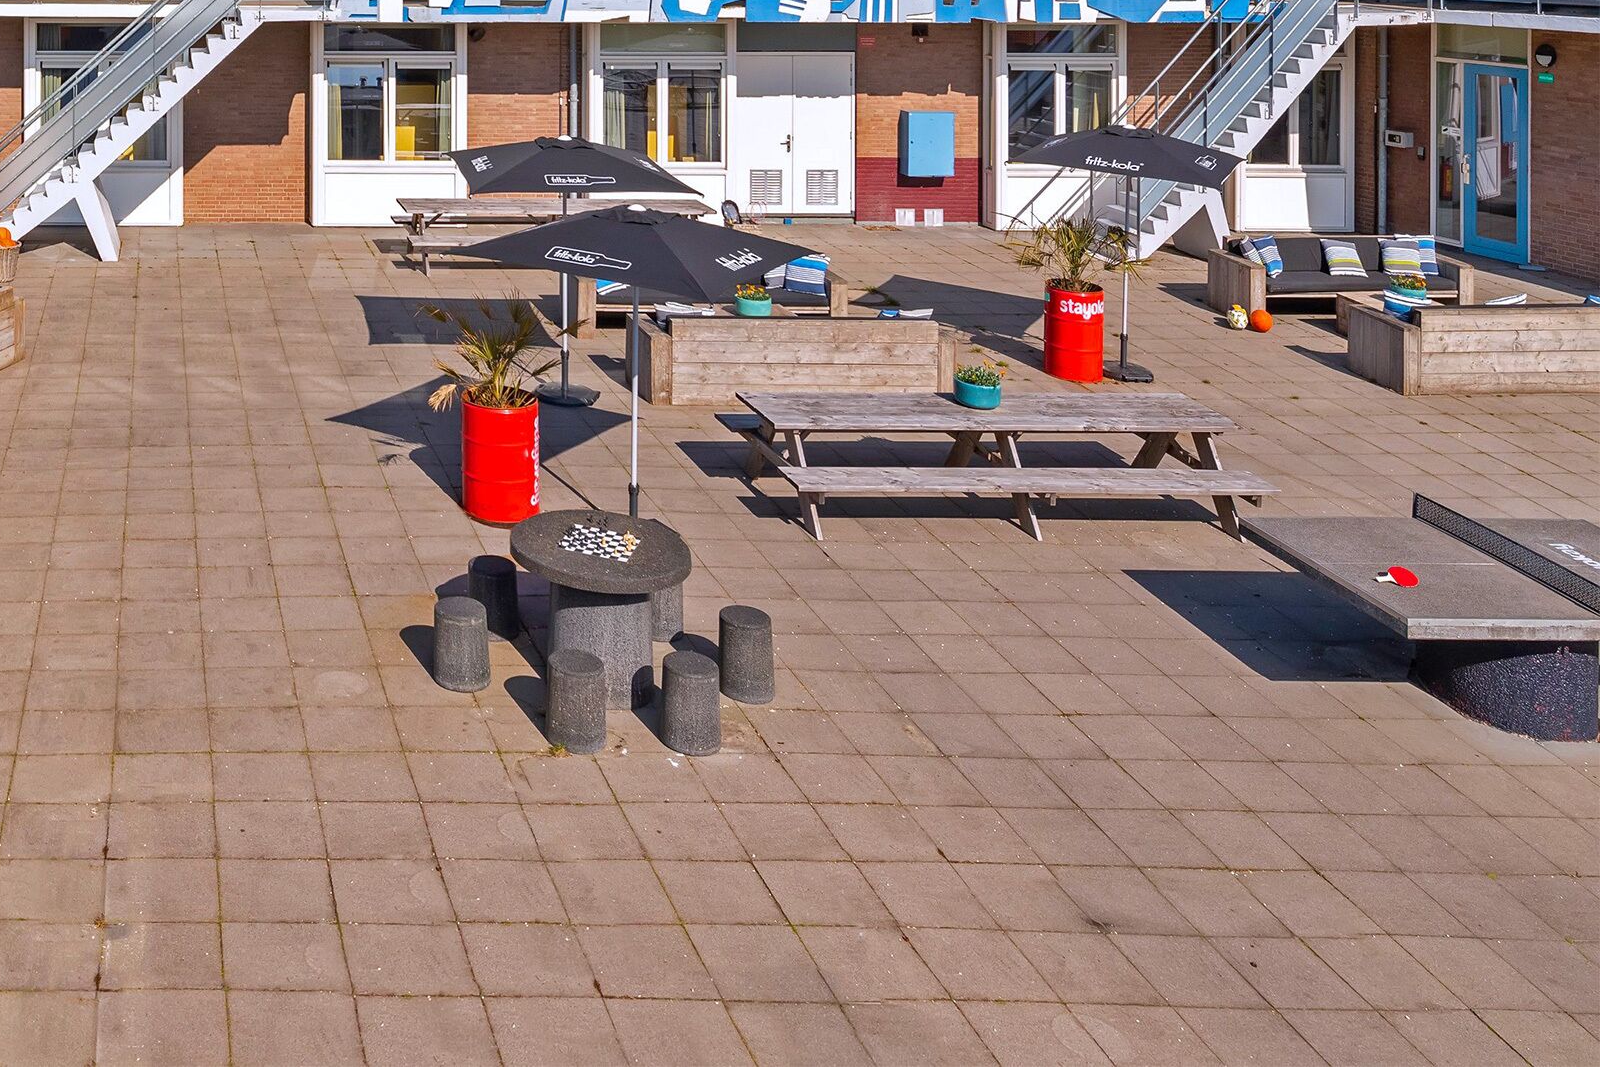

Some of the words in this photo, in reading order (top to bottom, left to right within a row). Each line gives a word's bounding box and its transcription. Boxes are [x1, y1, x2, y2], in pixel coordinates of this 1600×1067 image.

[1085, 155, 1142, 172] fritz-kola
[550, 176, 587, 184] fritz-kola
[553, 249, 596, 264] fritz-kola
[1059, 298, 1105, 320] stayok
